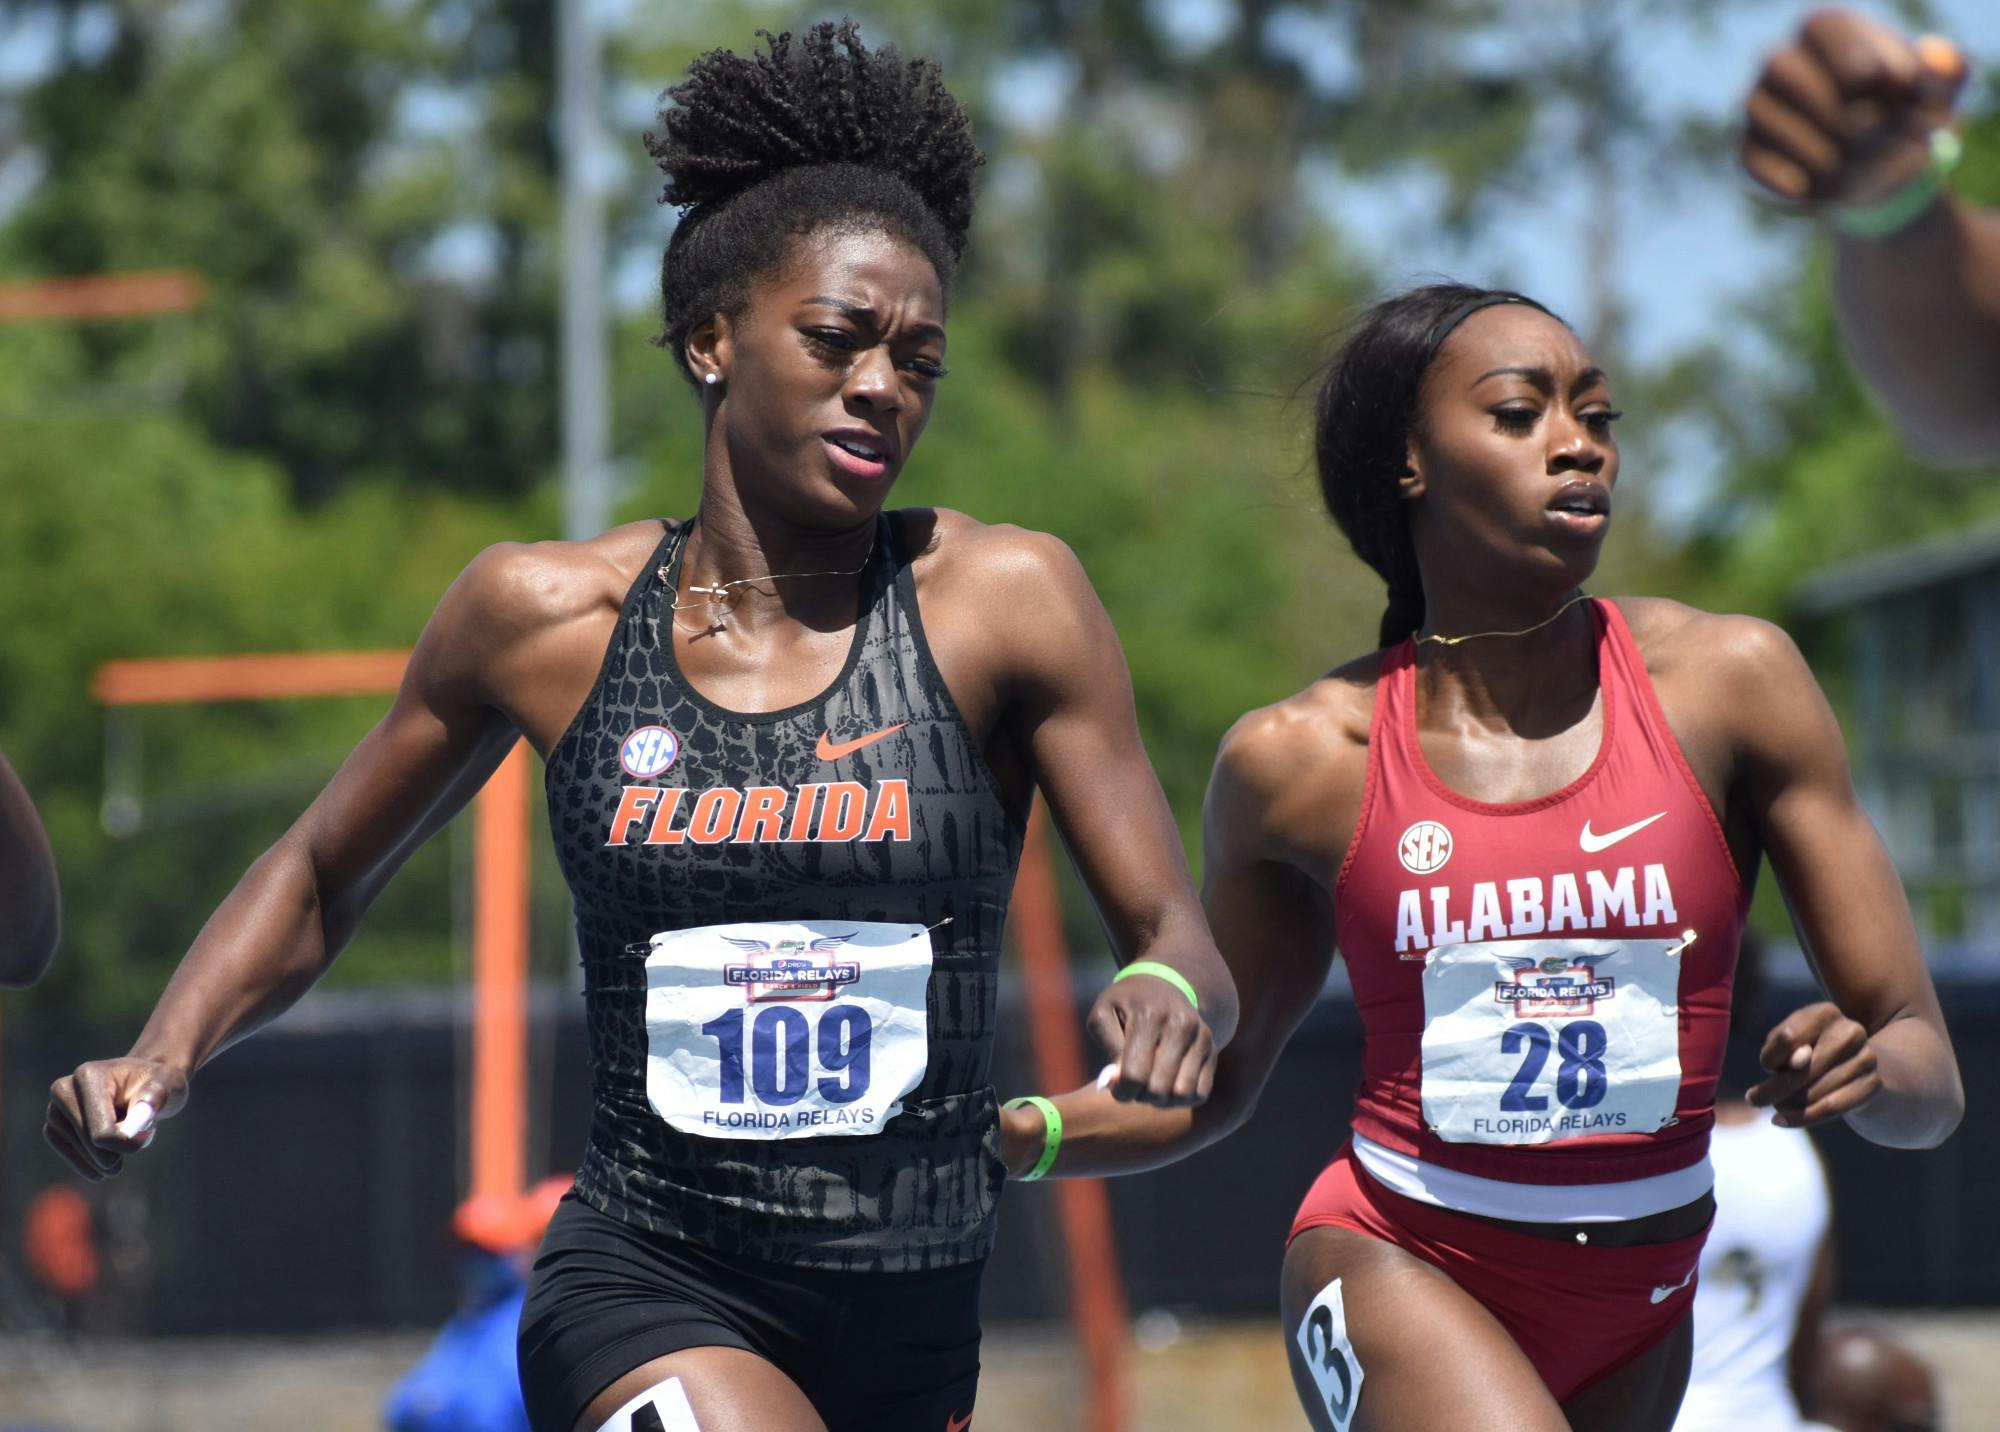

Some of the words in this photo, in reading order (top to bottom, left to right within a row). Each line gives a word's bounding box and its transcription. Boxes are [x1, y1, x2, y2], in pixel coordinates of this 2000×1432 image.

[625, 729, 675, 774] SEC
[604, 779, 911, 847] FLORIDA
[1402, 824, 1449, 870] SEC
[1394, 863, 1678, 952] ALABAMA
[732, 970, 794, 981] FLORIDA
[797, 969, 851, 981] RELAYS
[1502, 987, 1556, 998] FLORIDA
[1559, 985, 1606, 997] RELAYS
[702, 1004, 872, 1107] 109
[1500, 1020, 1608, 1112] 28
[703, 1110, 790, 1129] FLORIDA
[797, 1107, 874, 1125] RELAYS
[1473, 1117, 1554, 1134] FLORIDA
[1560, 1112, 1627, 1131] RELAYS
[1307, 1304, 1353, 1423] 3
